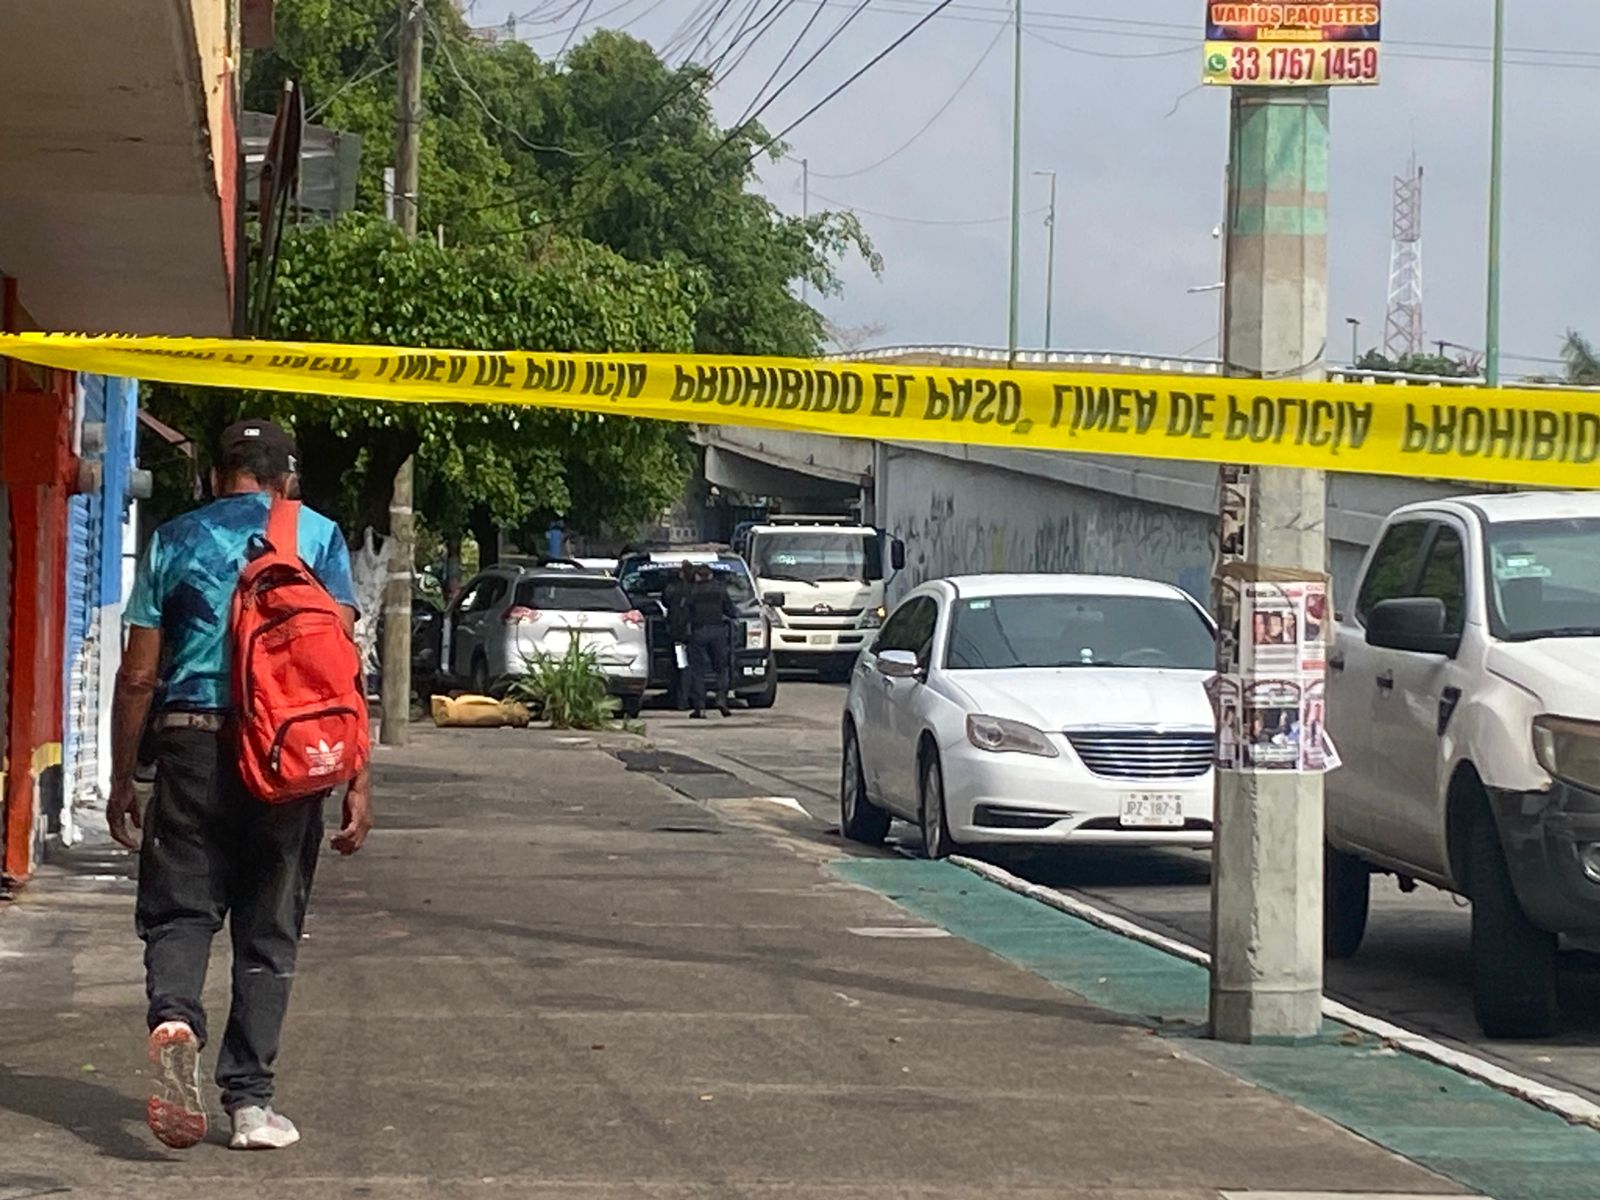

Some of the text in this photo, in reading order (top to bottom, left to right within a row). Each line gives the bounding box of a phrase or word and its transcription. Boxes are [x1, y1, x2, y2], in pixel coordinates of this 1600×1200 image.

[1213, 6, 1377, 24] VARIOS PAQUETES
[1231, 47, 1377, 80] 33 1767 1459
